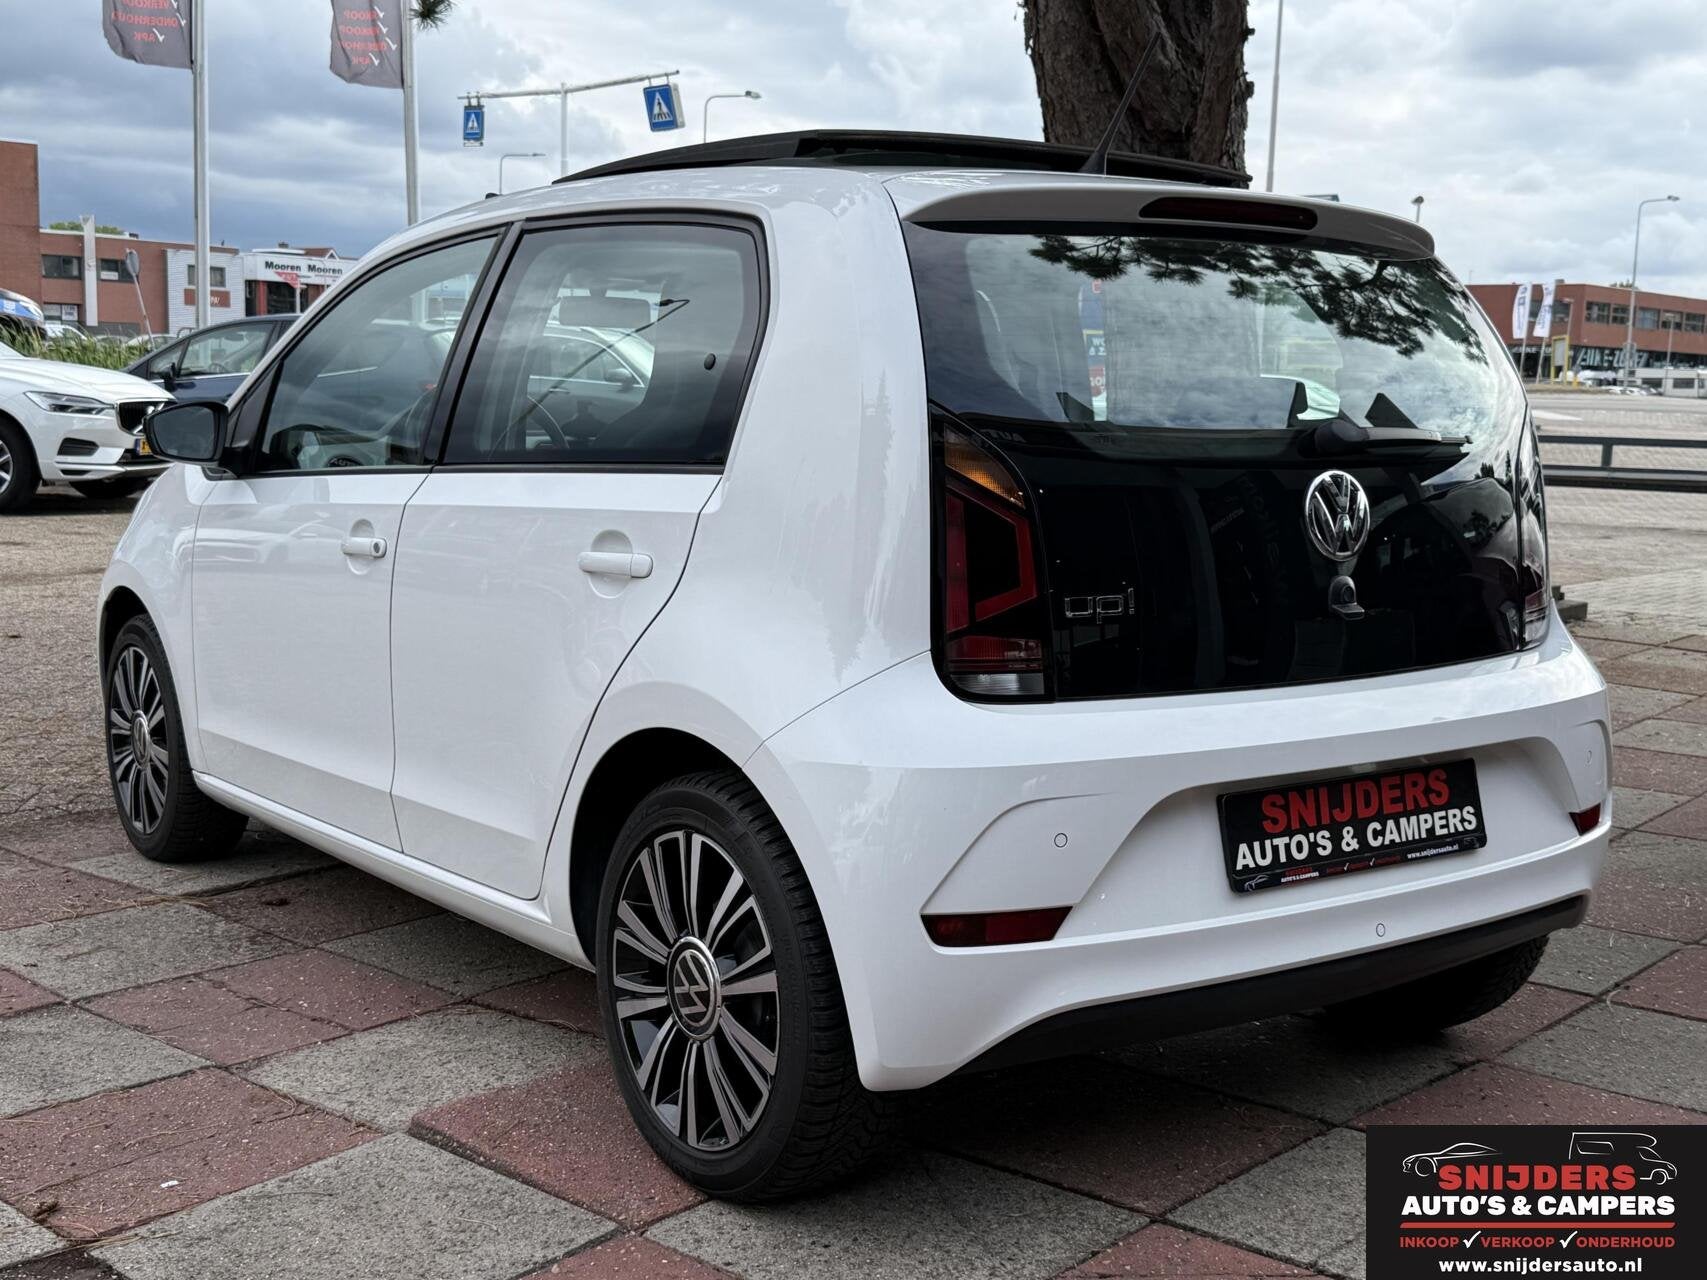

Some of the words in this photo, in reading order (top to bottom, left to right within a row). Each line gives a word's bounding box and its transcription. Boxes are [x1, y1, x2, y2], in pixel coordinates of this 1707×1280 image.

[264, 261, 302, 272] Mooren
[307, 264, 343, 274] Mooren
[1064, 587, 1135, 624] up!
[1261, 768, 1450, 834] SNIJDERS
[1235, 829, 1333, 871] AUTO'S
[1340, 826, 1360, 852] &
[1366, 805, 1478, 848] CAMPERS
[1406, 843, 1459, 859] www.snijdersauto.nl
